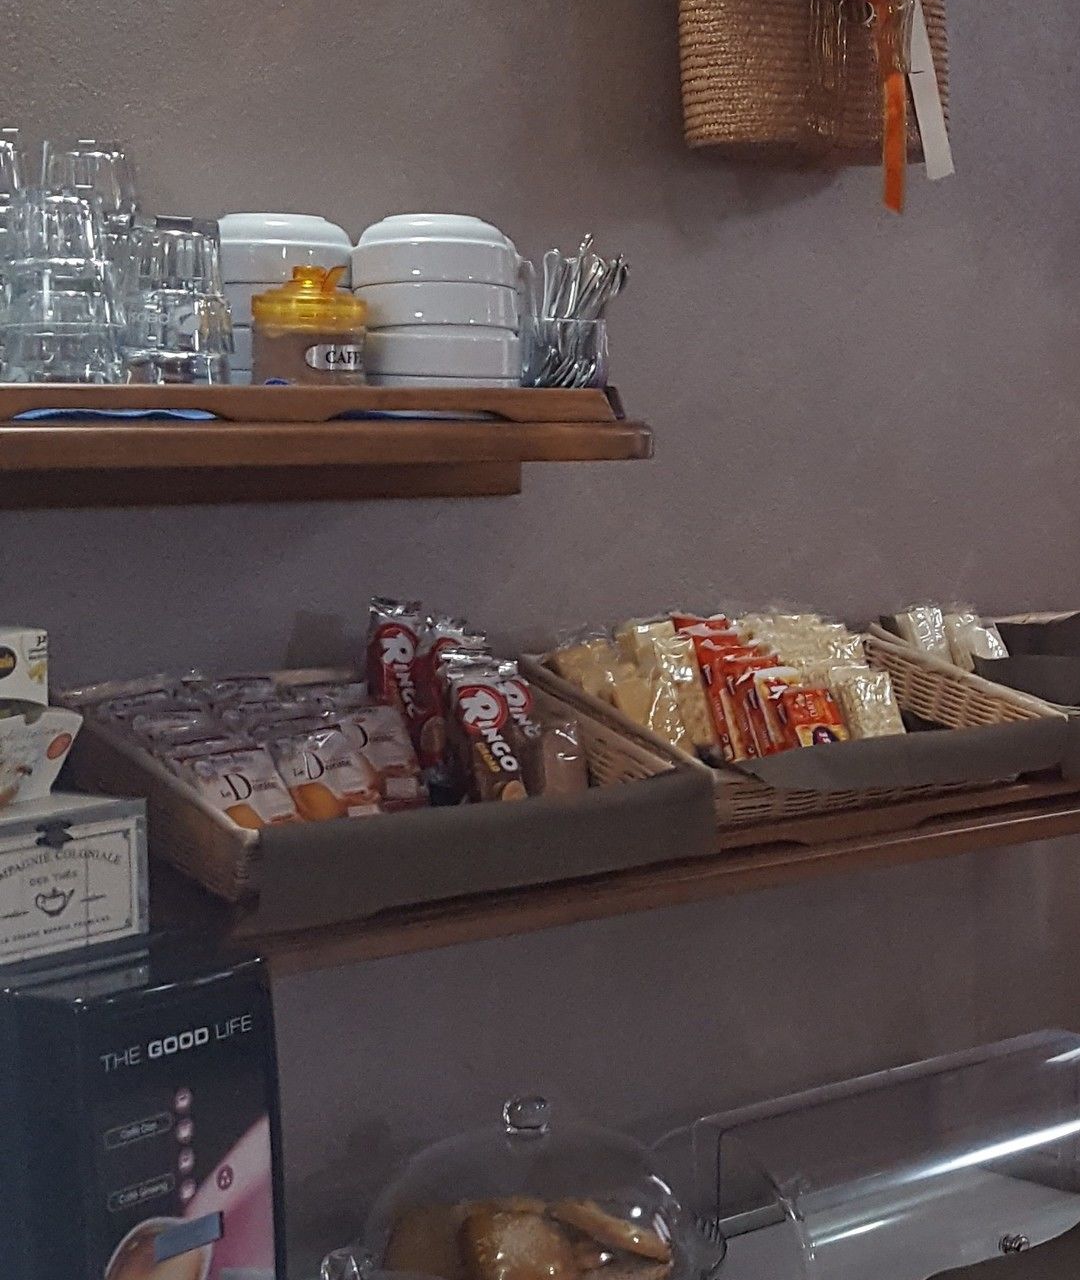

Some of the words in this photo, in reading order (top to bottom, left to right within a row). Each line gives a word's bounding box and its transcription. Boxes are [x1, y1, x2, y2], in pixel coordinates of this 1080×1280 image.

[460, 689, 519, 772] RINGO
[101, 1045, 141, 1072] THE
[148, 1027, 209, 1059] GOOD
[215, 1014, 252, 1039] LIFE
